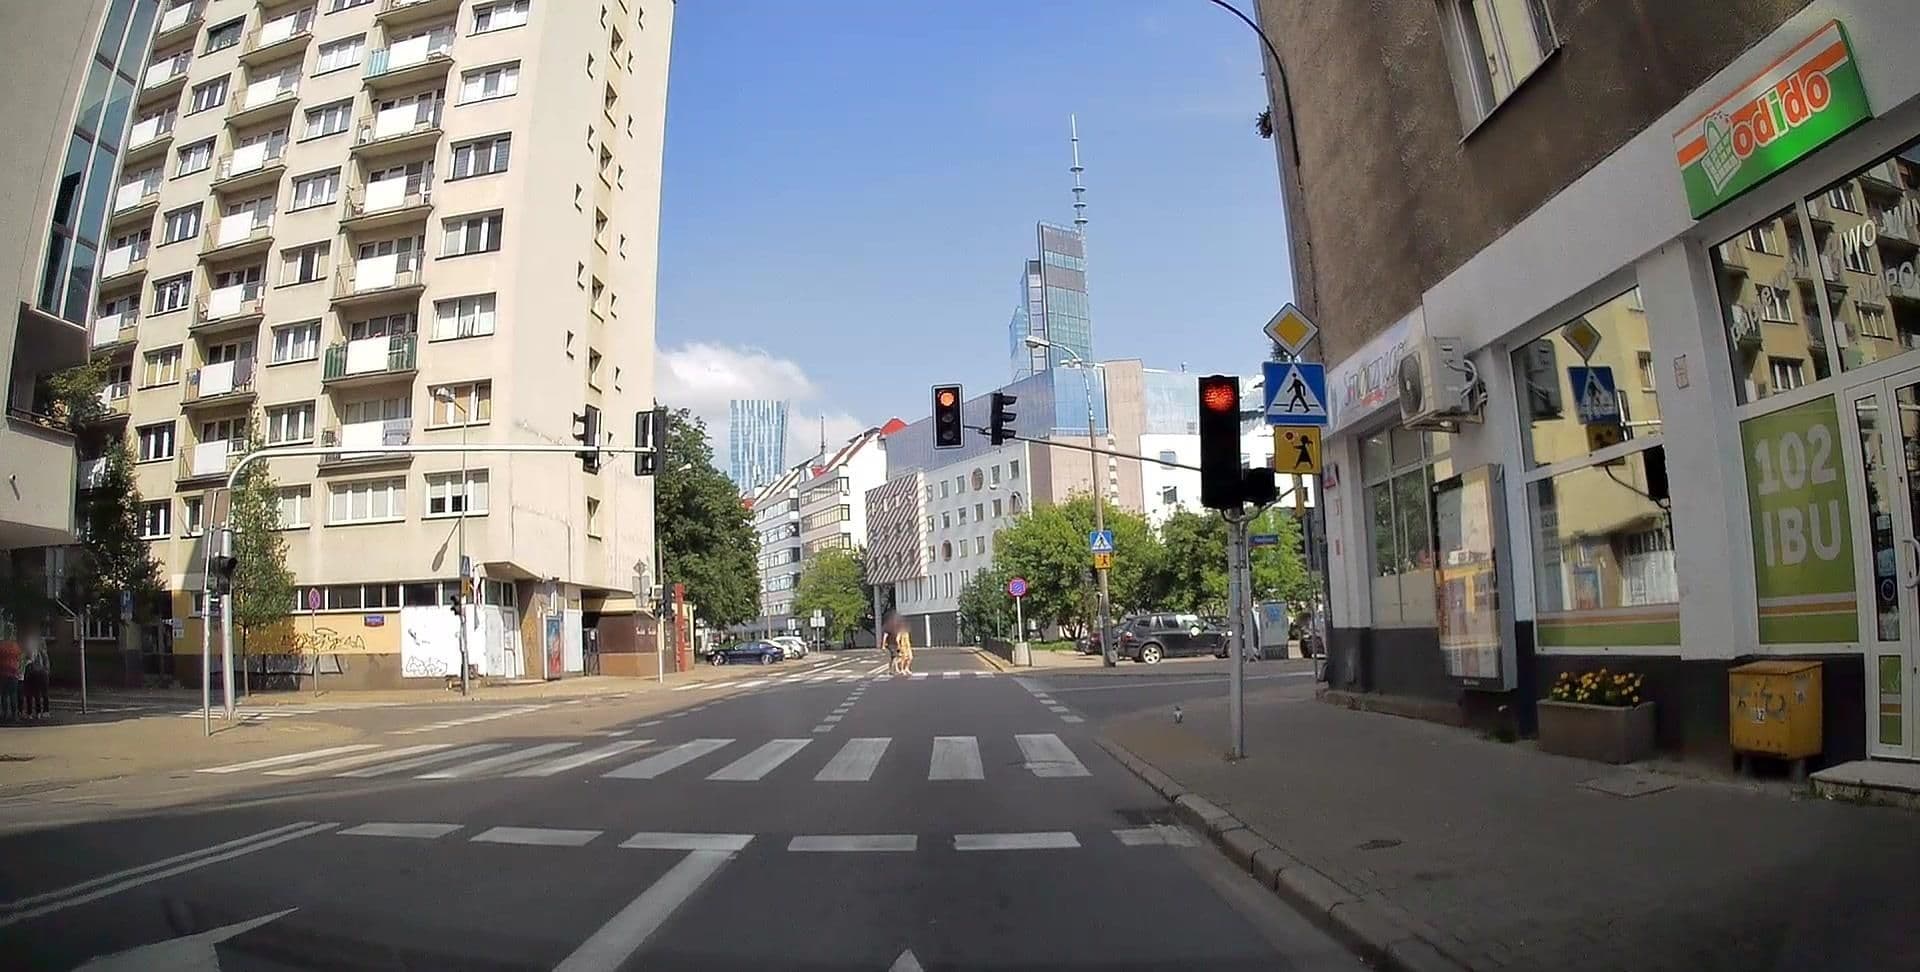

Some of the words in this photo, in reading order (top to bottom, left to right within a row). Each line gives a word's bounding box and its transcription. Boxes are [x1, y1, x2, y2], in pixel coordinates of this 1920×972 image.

[1732, 70, 1830, 159] odido
[1754, 423, 1837, 496] 102
[1761, 499, 1841, 567] IBU
